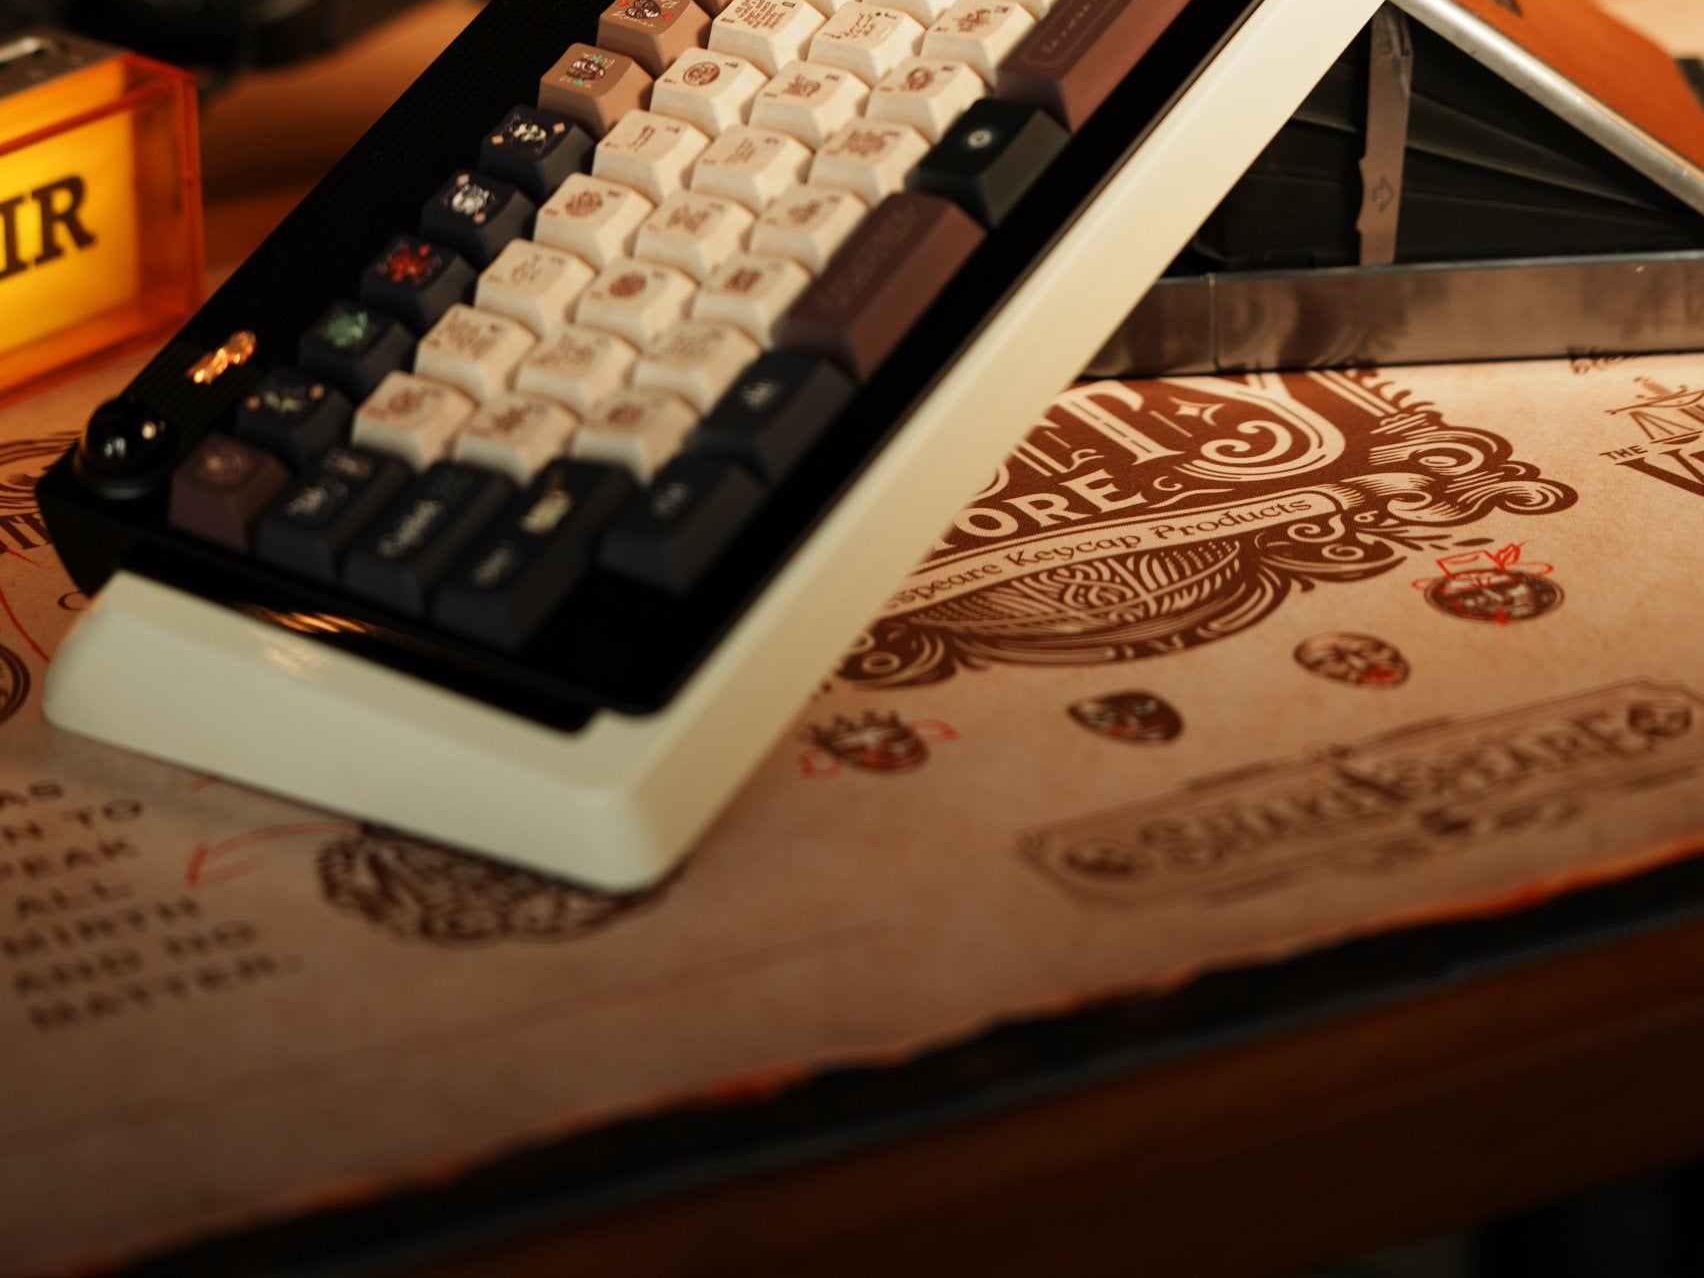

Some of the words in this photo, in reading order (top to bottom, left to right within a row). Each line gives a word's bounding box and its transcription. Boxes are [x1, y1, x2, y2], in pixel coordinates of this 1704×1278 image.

[0, 174, 98, 281] IR
[1598, 445, 1649, 461] THE
[938, 469, 1150, 549] ORE
[1005, 533, 1142, 568] Keycap
[1151, 496, 1315, 542] Products
